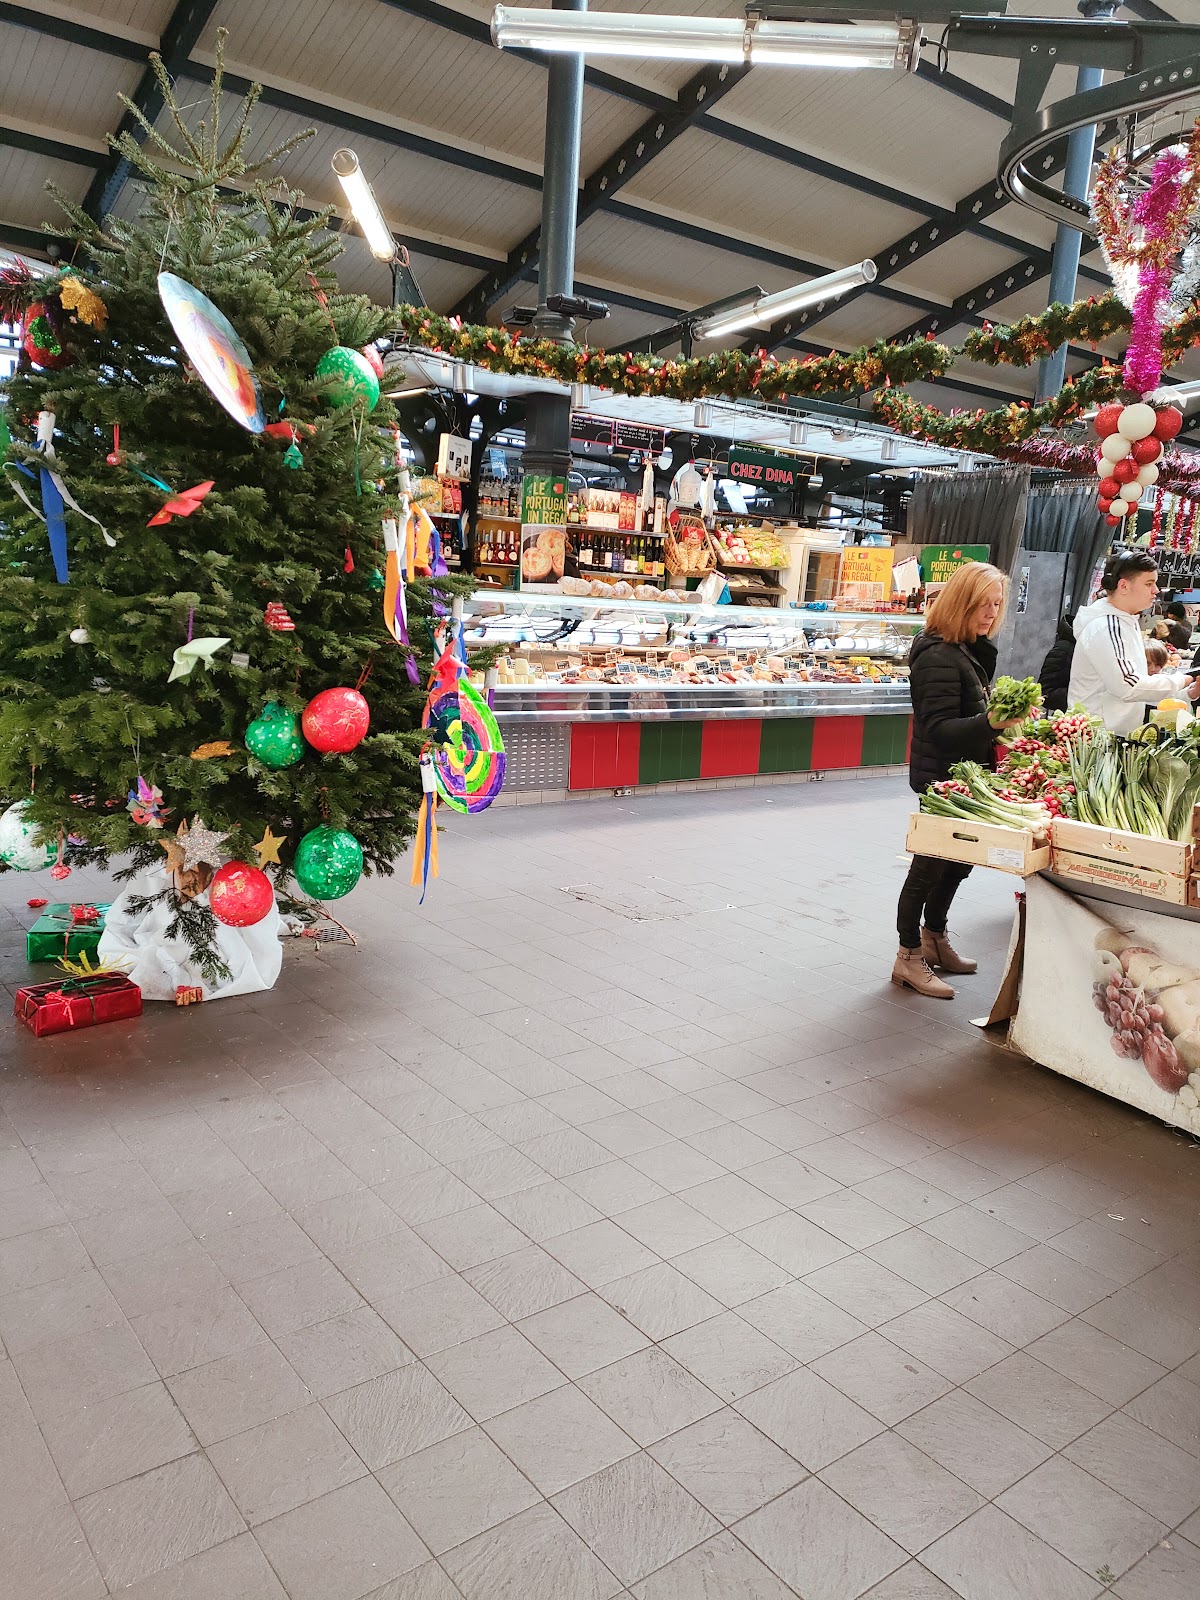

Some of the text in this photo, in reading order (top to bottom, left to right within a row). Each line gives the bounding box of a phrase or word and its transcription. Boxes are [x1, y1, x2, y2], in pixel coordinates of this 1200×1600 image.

[731, 462, 793, 485] CHEZ DINA
[533, 482, 546, 495] LE
[528, 509, 566, 525] UN RÉGA
[848, 552, 855, 560] LE
[939, 551, 948, 560] LE
[843, 561, 874, 572] ORTUGAL,
[852, 570, 872, 582] RÉGAL
[932, 571, 952, 582] UN RÉ
